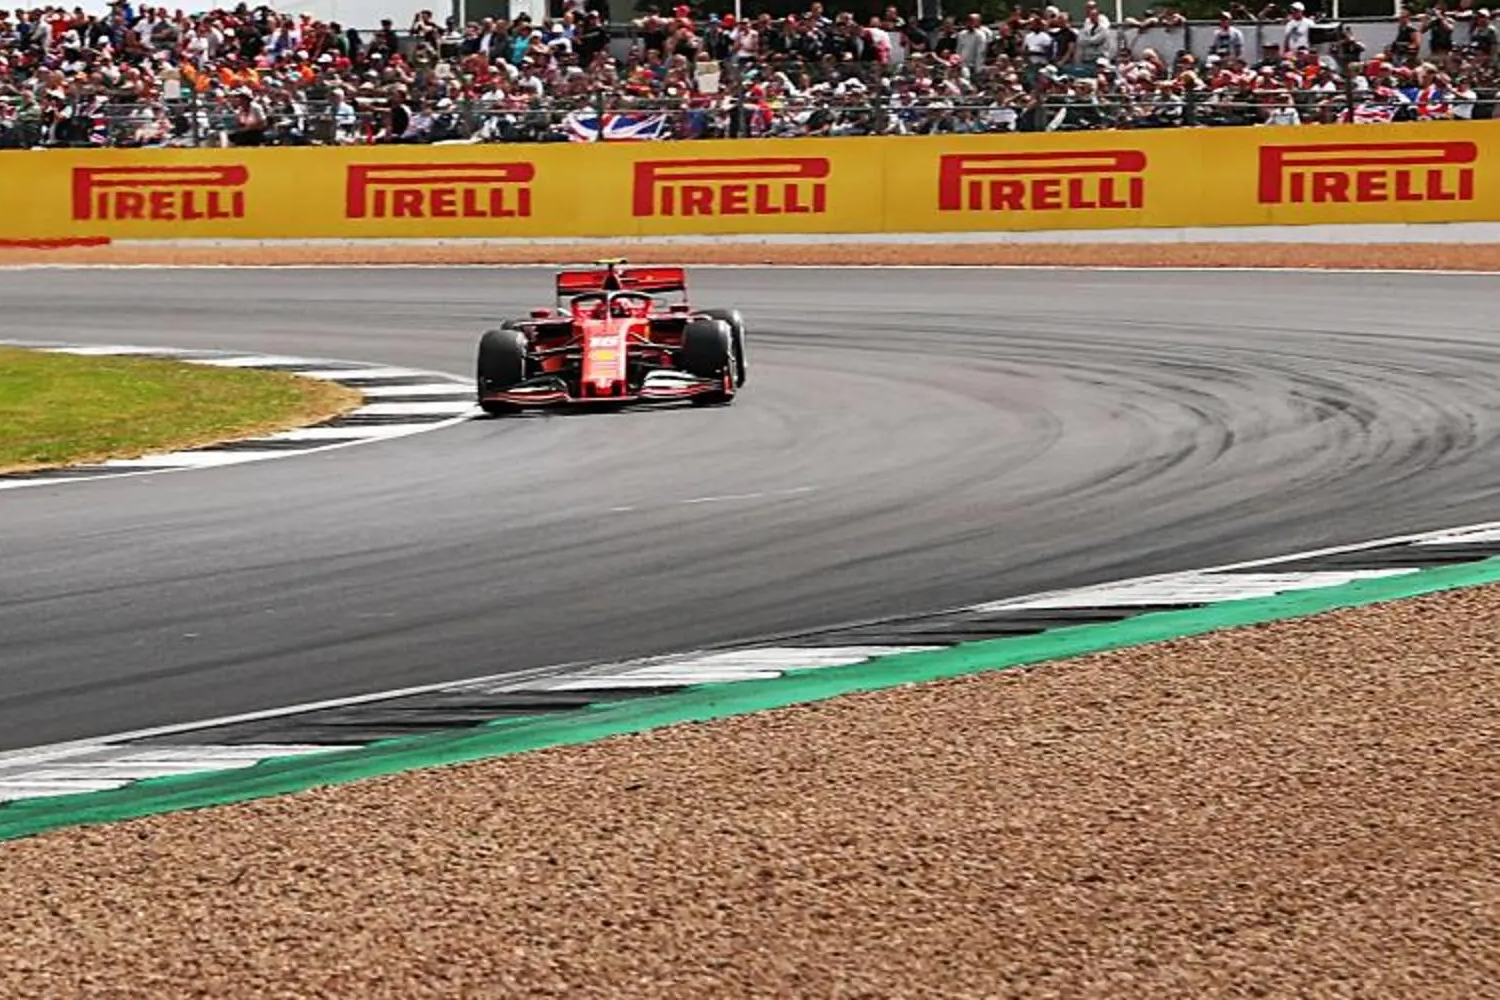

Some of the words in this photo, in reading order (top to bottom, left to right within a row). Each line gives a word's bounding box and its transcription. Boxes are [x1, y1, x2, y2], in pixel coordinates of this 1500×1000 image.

[71, 165, 249, 221] PIRELLI
[345, 162, 537, 219] PIRELLI
[632, 157, 830, 217] PIRELLI
[939, 150, 1148, 212] PIRELLI
[1258, 141, 1478, 205] PIRELLI
